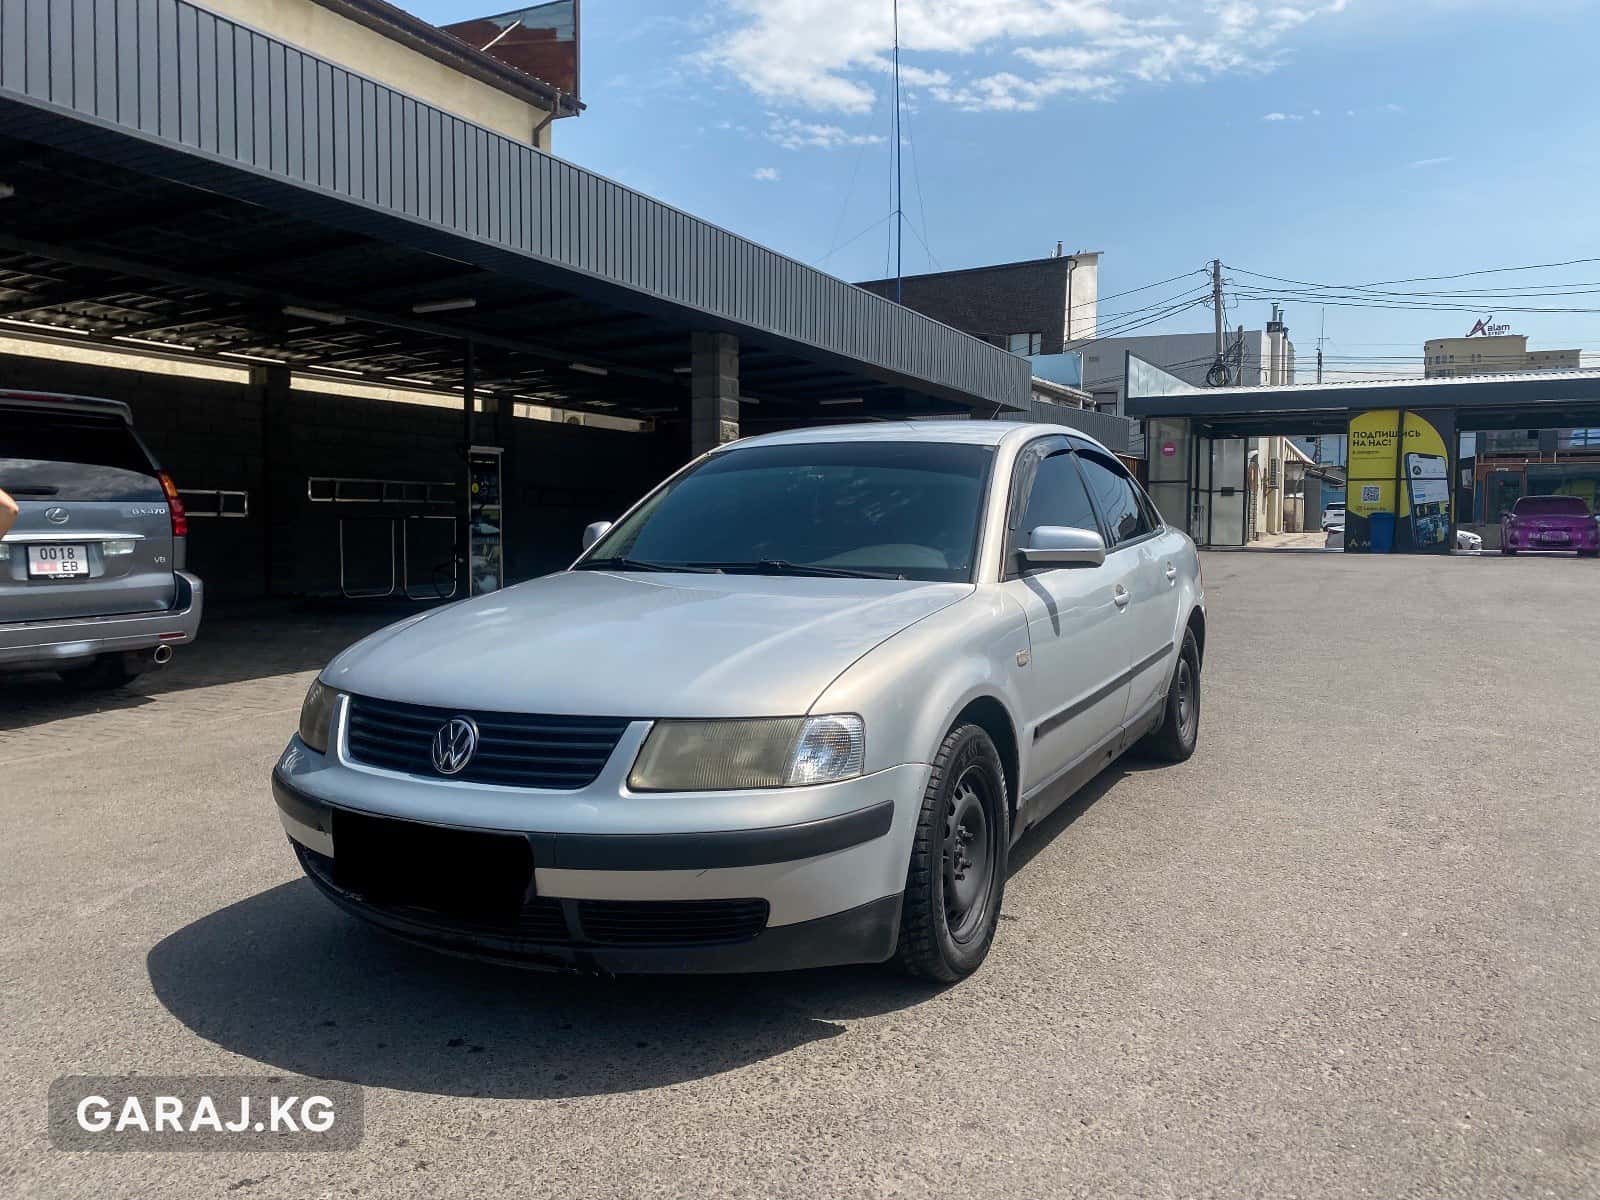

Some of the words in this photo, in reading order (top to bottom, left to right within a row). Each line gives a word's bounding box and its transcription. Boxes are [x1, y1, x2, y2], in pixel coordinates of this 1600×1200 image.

[1368, 439, 1392, 447] НАС!
[40, 547, 75, 560] 0018
[62, 561, 78, 571] EB
